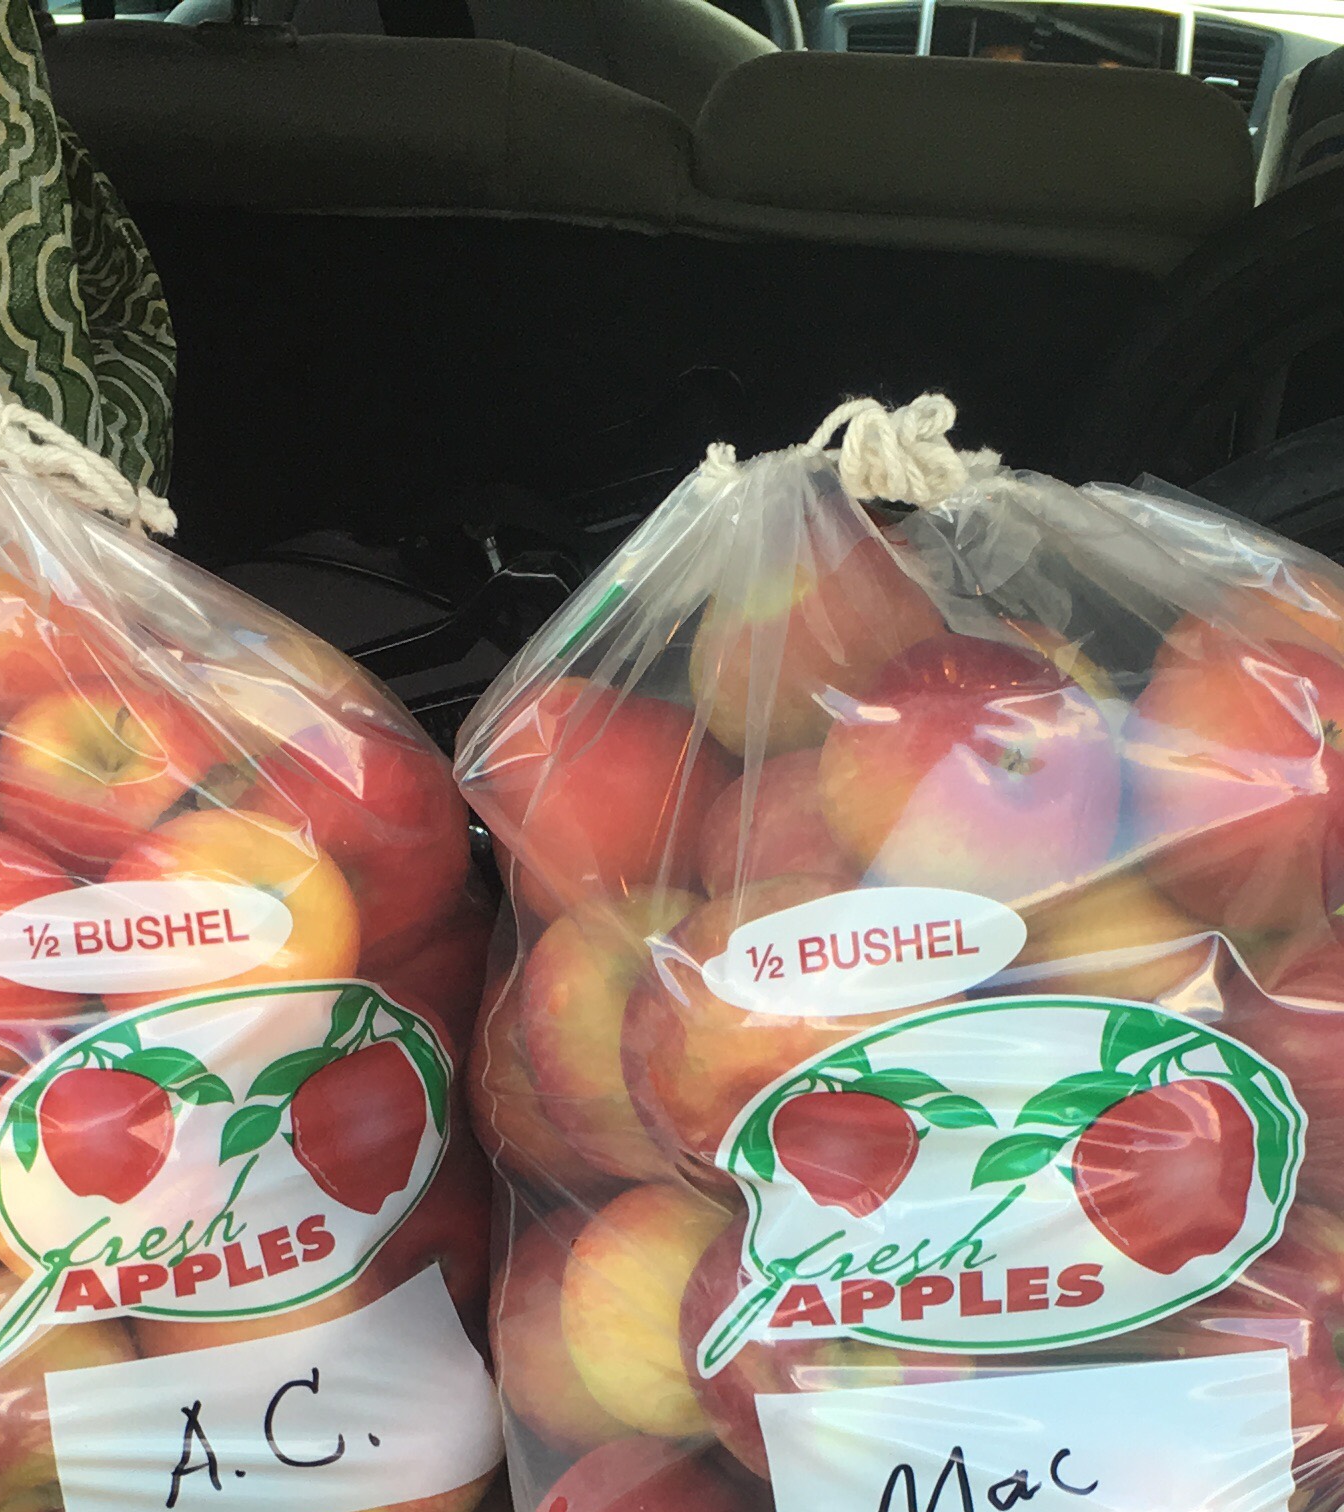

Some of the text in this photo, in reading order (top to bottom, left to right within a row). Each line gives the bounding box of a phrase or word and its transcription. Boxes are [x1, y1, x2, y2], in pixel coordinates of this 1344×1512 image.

[73, 908, 250, 955] BUSHEL
[798, 919, 980, 975] BUSHEL
[55, 1214, 336, 1312] APPLES
[768, 1263, 1105, 1328] APPLES
